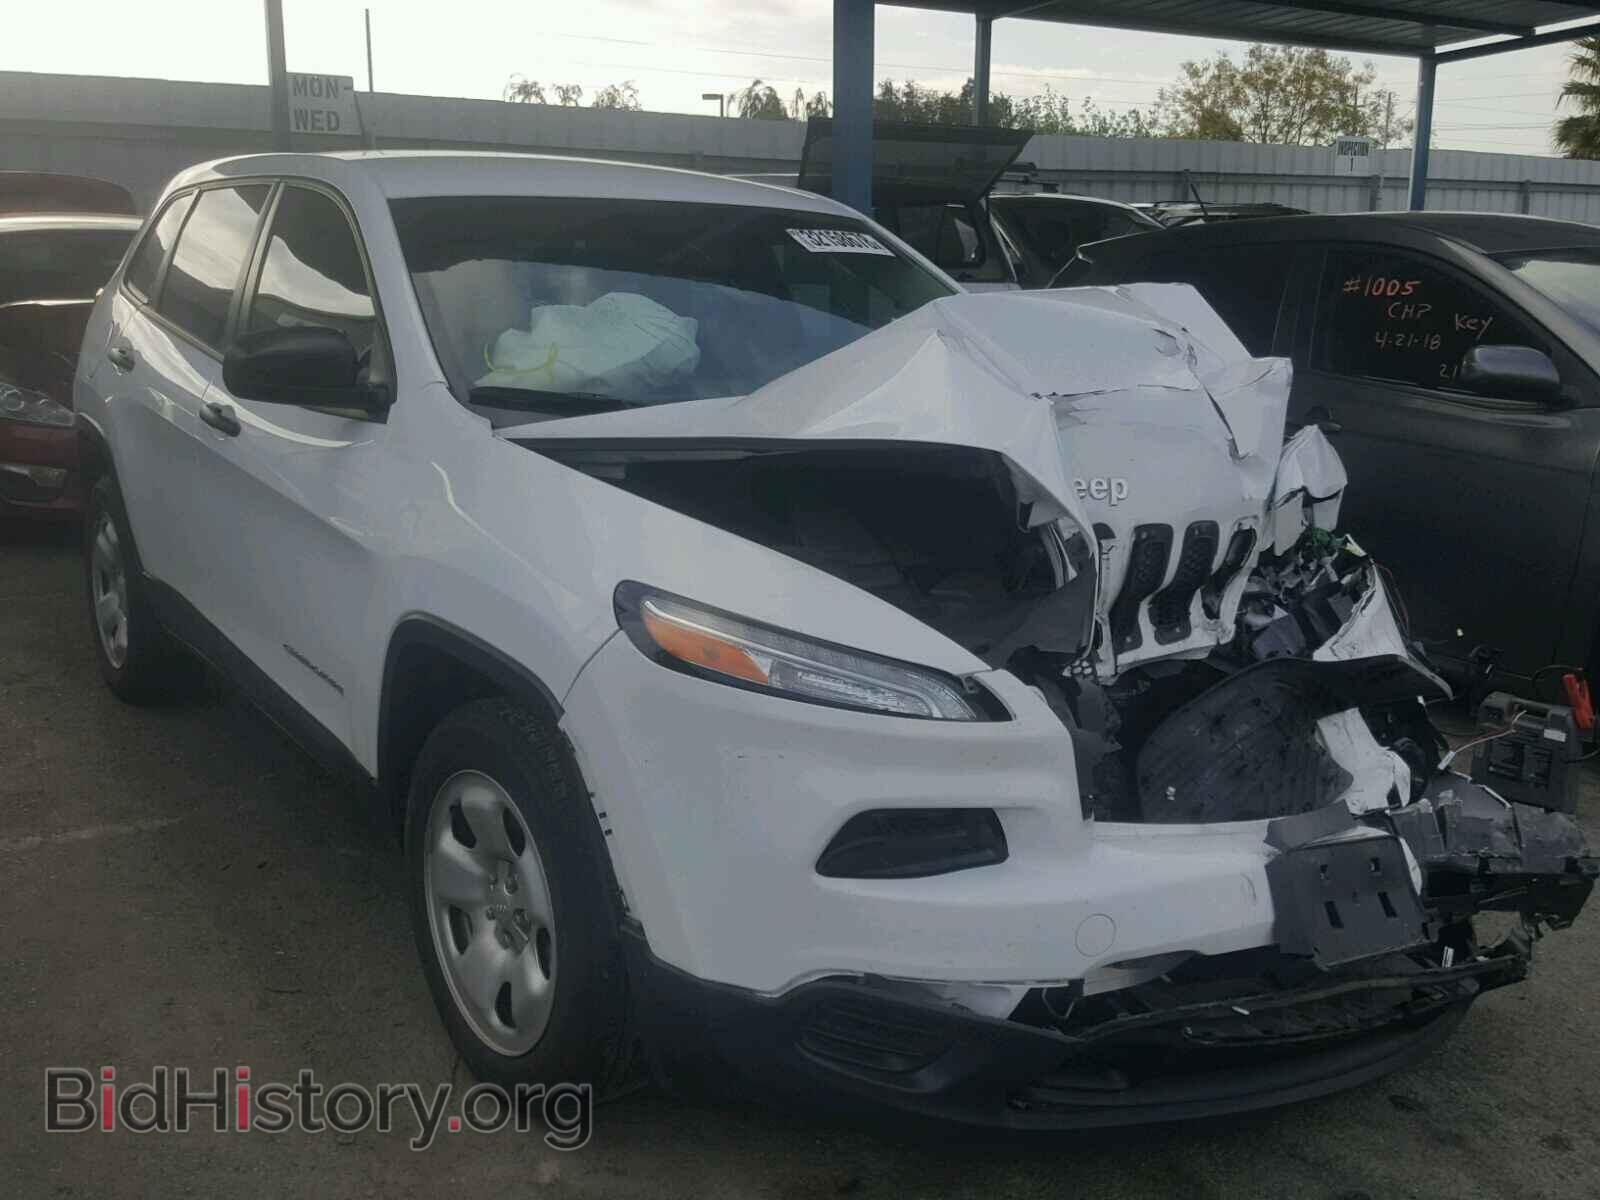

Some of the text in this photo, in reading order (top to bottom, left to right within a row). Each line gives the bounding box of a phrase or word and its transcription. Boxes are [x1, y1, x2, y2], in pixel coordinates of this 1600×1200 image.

[294, 77, 338, 99] MON
[294, 108, 340, 130] WED
[1343, 274, 1421, 296] #1005
[1073, 479, 1129, 507] eep
